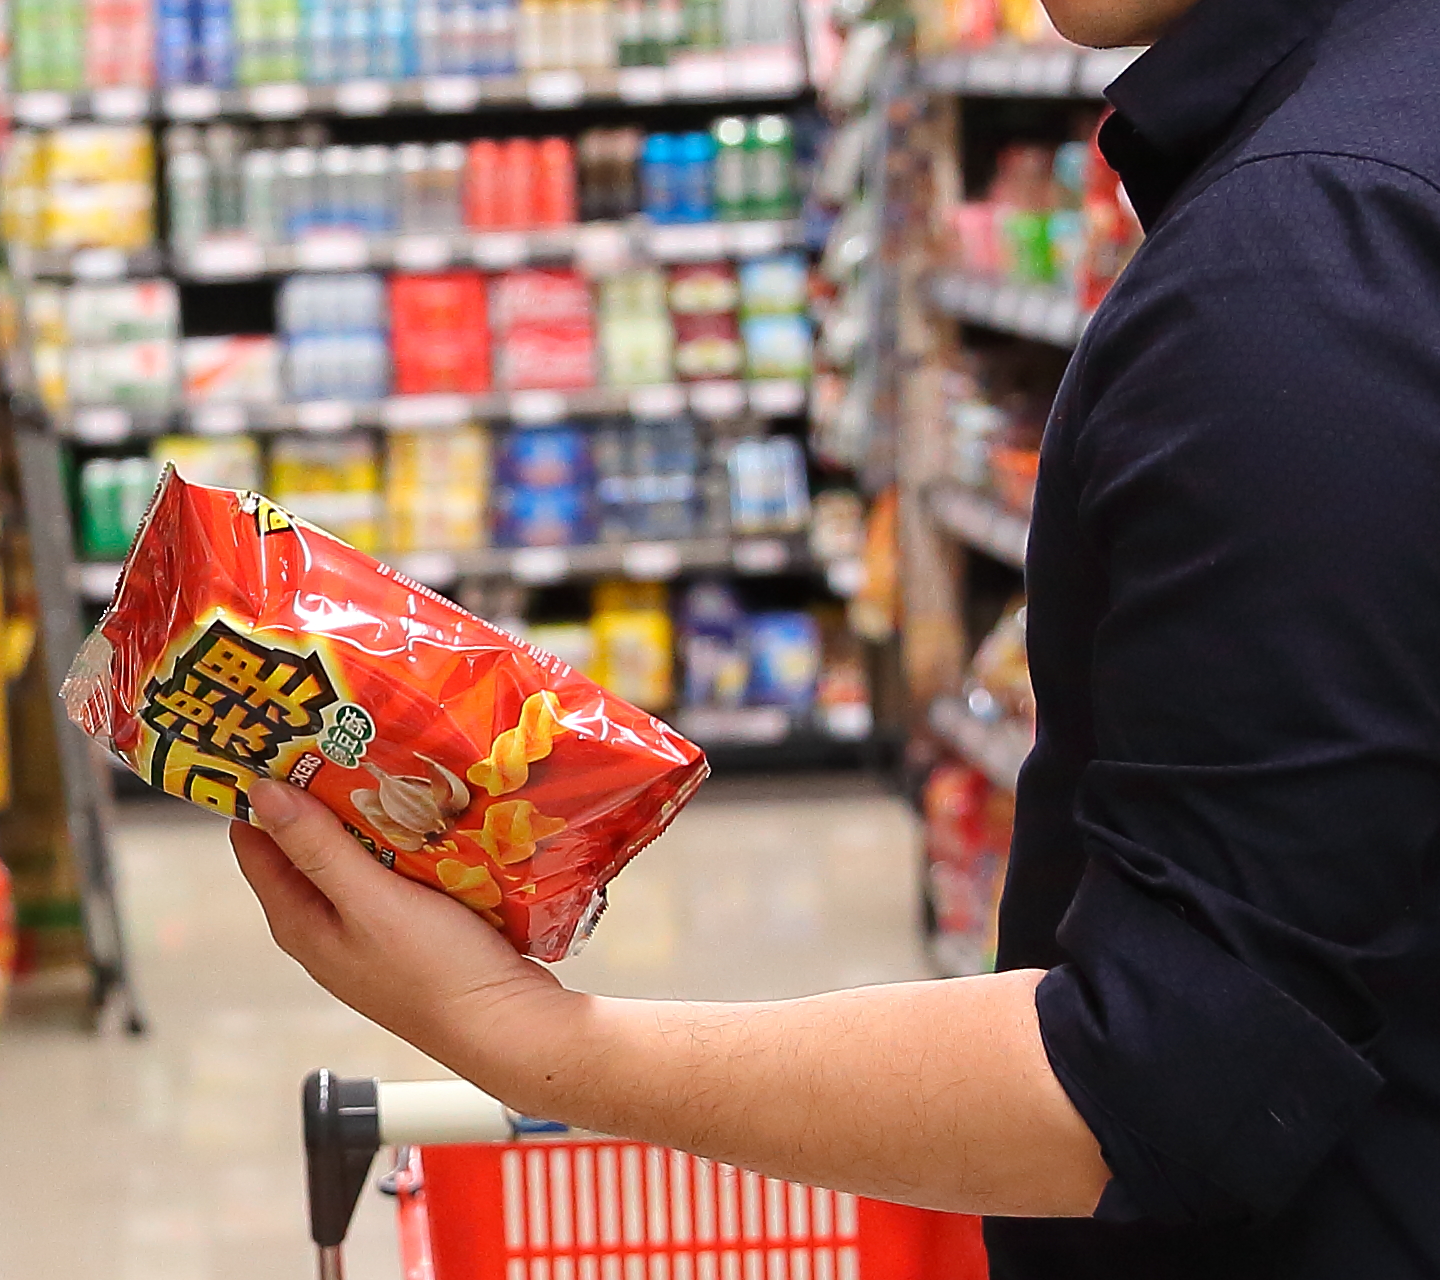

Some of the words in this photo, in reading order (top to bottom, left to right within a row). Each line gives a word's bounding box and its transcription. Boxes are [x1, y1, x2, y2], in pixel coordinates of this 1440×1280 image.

[154, 632, 324, 818] 可樂果
[288, 753, 322, 792] CKERS
